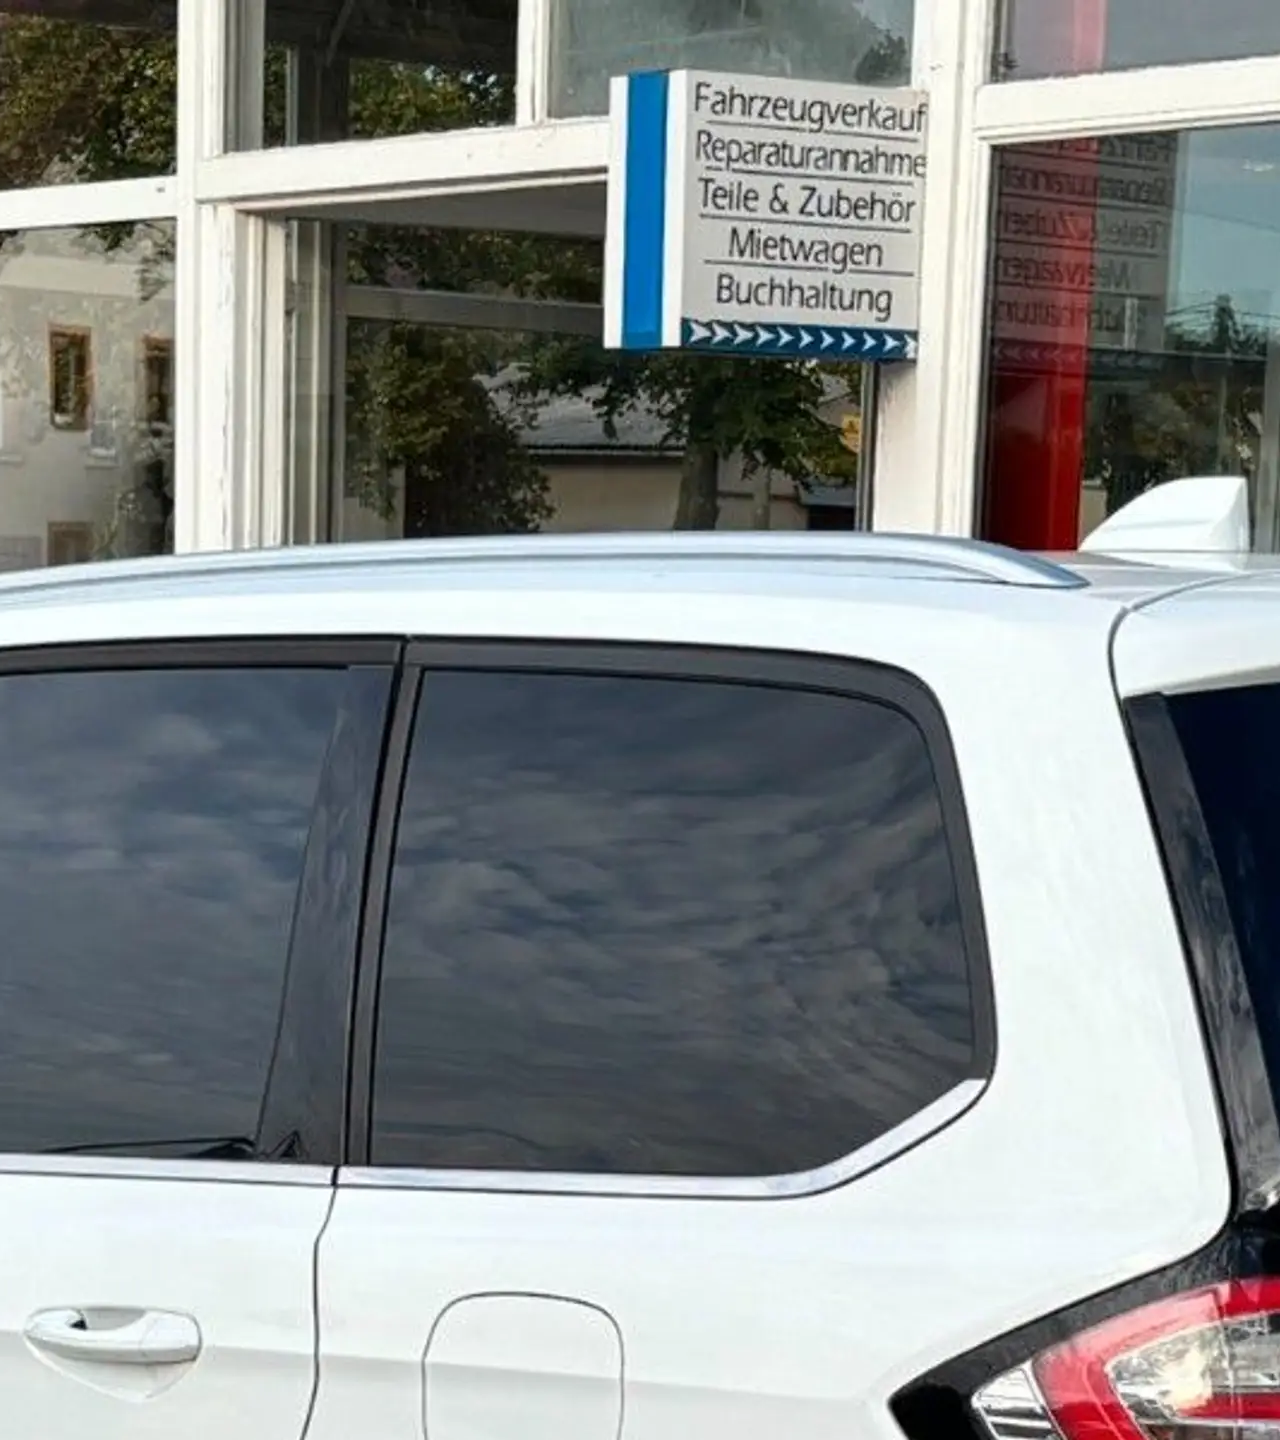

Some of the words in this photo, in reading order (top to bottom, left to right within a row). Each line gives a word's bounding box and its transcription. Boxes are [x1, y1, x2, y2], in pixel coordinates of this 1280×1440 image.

[694, 81, 928, 133] Fahrzeugverkauf
[695, 129, 928, 178] Reparaturannahme
[698, 177, 760, 212] Teile
[769, 183, 789, 216] &
[799, 185, 915, 222] Zubehör
[728, 227, 883, 274] Mietwagen
[716, 273, 893, 321] Buchhaltung
